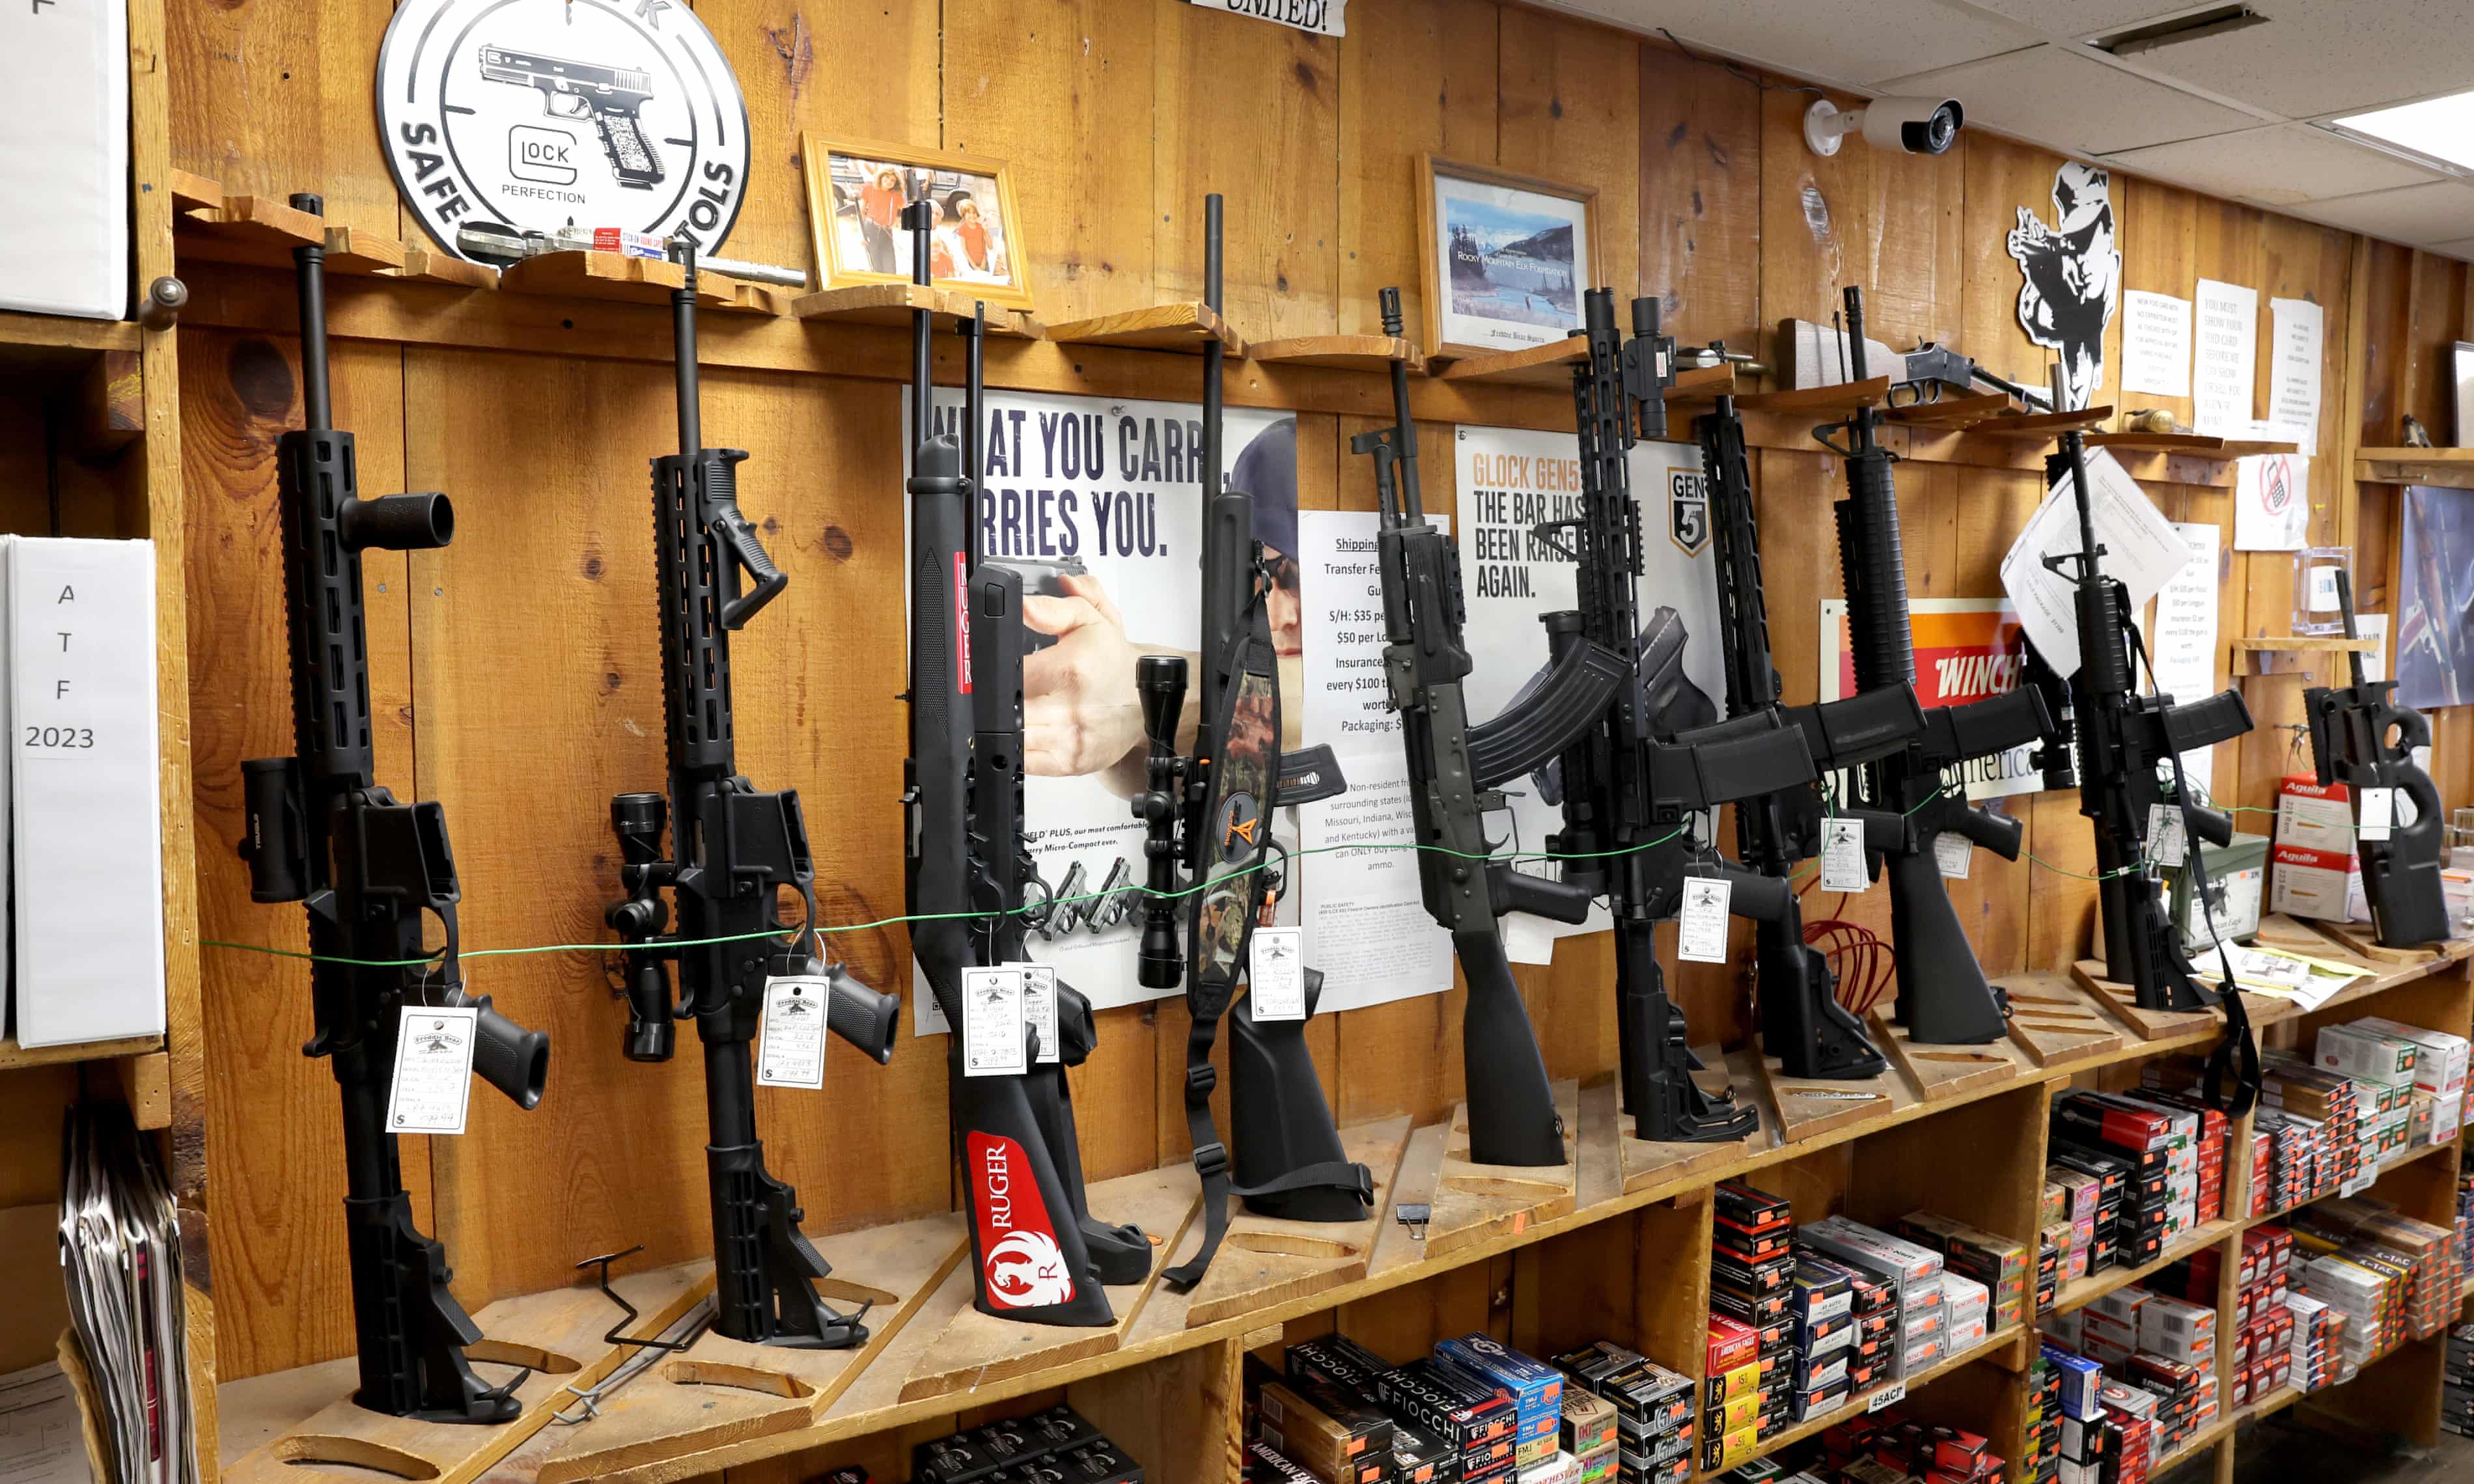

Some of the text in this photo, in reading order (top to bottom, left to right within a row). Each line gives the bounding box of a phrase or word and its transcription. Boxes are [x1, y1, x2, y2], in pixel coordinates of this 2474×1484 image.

[401, 122, 471, 225] SAFE
[501, 184, 586, 205] PERFECTION
[1458, 251, 1568, 277] ROCKY MOUNTAIN ELK FOUNDATION
[2204, 298, 2218, 312] YOU
[2204, 315, 2225, 329] SHOW
[1039, 411, 1230, 491] YOU CARR,
[1473, 452, 1530, 489] GLOCK
[1673, 475, 1705, 499] GEN
[1473, 490, 1586, 525] THE BAR HAS
[984, 489, 1167, 557] RRIES YOU.
[1680, 504, 1703, 543] 5
[1475, 528, 1577, 562] BEEN RAISE
[1324, 563, 1381, 575] Transfer Fe
[1477, 565, 1536, 598] AGAIN.
[1367, 586, 1381, 596] Gu
[960, 562, 972, 684] RUGER
[1329, 610, 1385, 623] S/H: $35 pe
[1337, 631, 1355, 643] $50
[1358, 634, 1374, 646] per
[1326, 679, 1353, 691] every
[1355, 676, 1380, 689] $100
[1935, 652, 2022, 698] WINCH
[1341, 720, 1394, 732] Packaging:
[25, 726, 94, 749] 2023
[1964, 747, 2038, 784] merica
[1350, 780, 1400, 792] Non-resident
[2286, 782, 2328, 796] Aguila
[1330, 796, 1402, 811] surrounding states
[1325, 810, 1412, 828] Missouri, Indiana, Wisc
[1049, 828, 1073, 838] PLUS,
[1088, 826, 1105, 834] most
[1325, 835, 1339, 844] and
[1342, 829, 1380, 842] Kentucky)
[1382, 827, 1398, 837] with
[1029, 846, 1043, 855] arry
[1044, 840, 1100, 853] Micro-Compact
[1335, 850, 1349, 859] can
[2278, 850, 2318, 864] Aguila
[1368, 861, 1395, 871] ammo.
[415, 1034, 460, 1044] Freddie Bear
[986, 1142, 1012, 1230] RUGER
[1038, 1262, 1058, 1281] R
[1525, 1395, 1538, 1405] TMJ
[1393, 1391, 1460, 1440] FIOCCHI
[1522, 1424, 1535, 1433] TMJ
[1518, 1444, 1532, 1455] FMJ
[1249, 1441, 1299, 1479] AMERICAN
